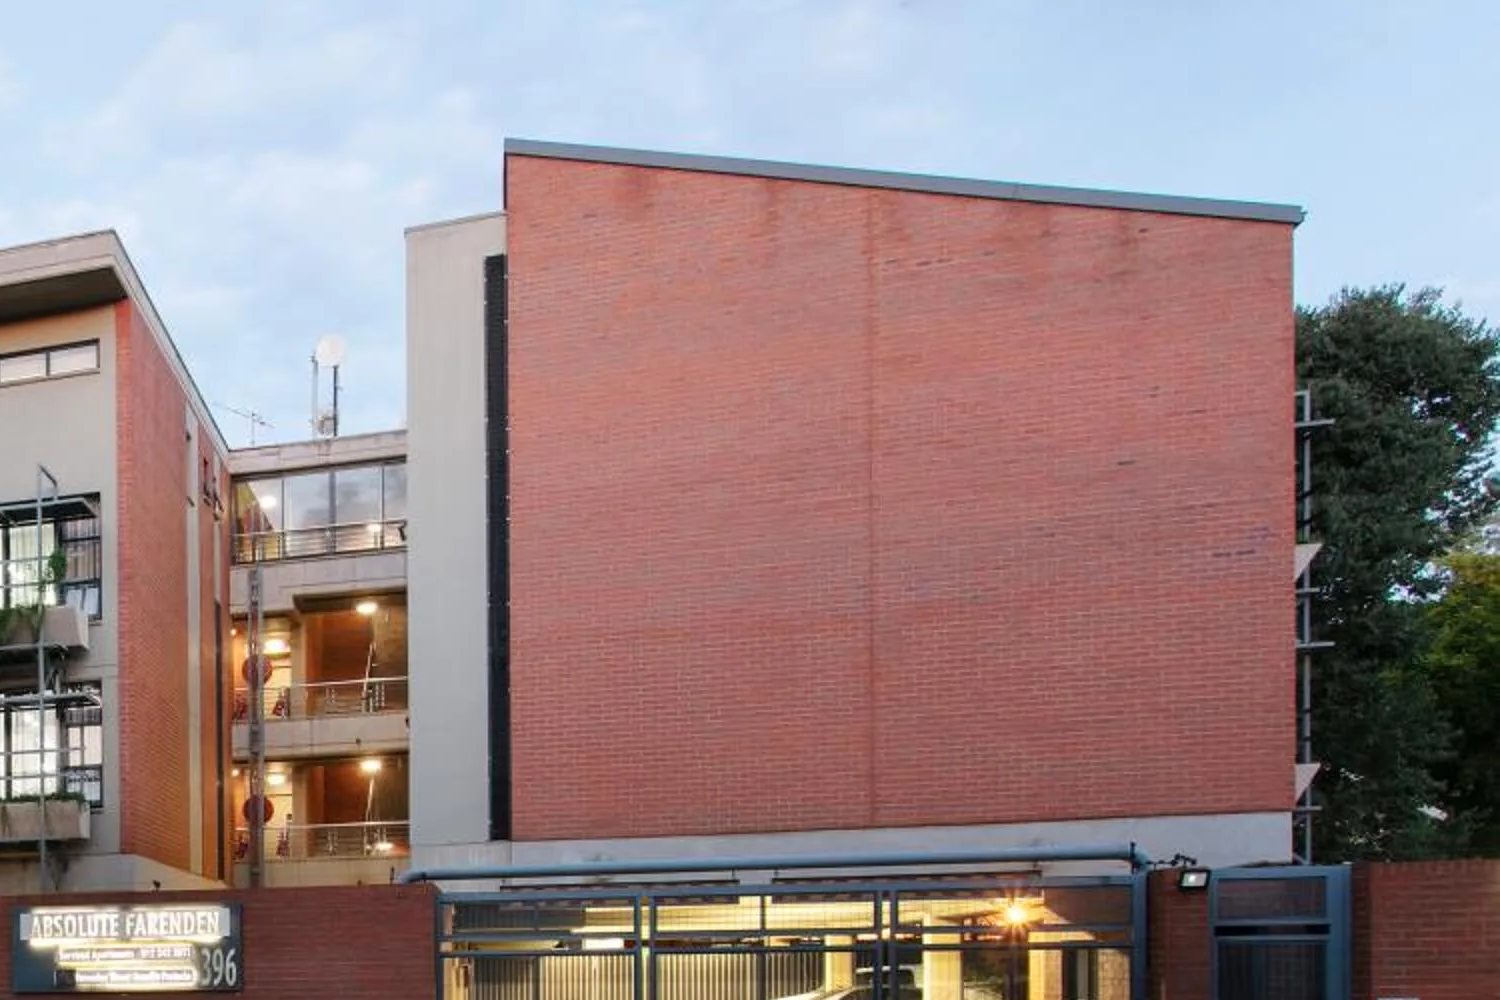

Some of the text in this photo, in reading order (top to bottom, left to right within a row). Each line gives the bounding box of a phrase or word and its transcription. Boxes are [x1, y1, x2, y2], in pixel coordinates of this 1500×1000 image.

[31, 910, 220, 938] ABSOLUTE FARENDEN
[202, 947, 237, 987] 396
